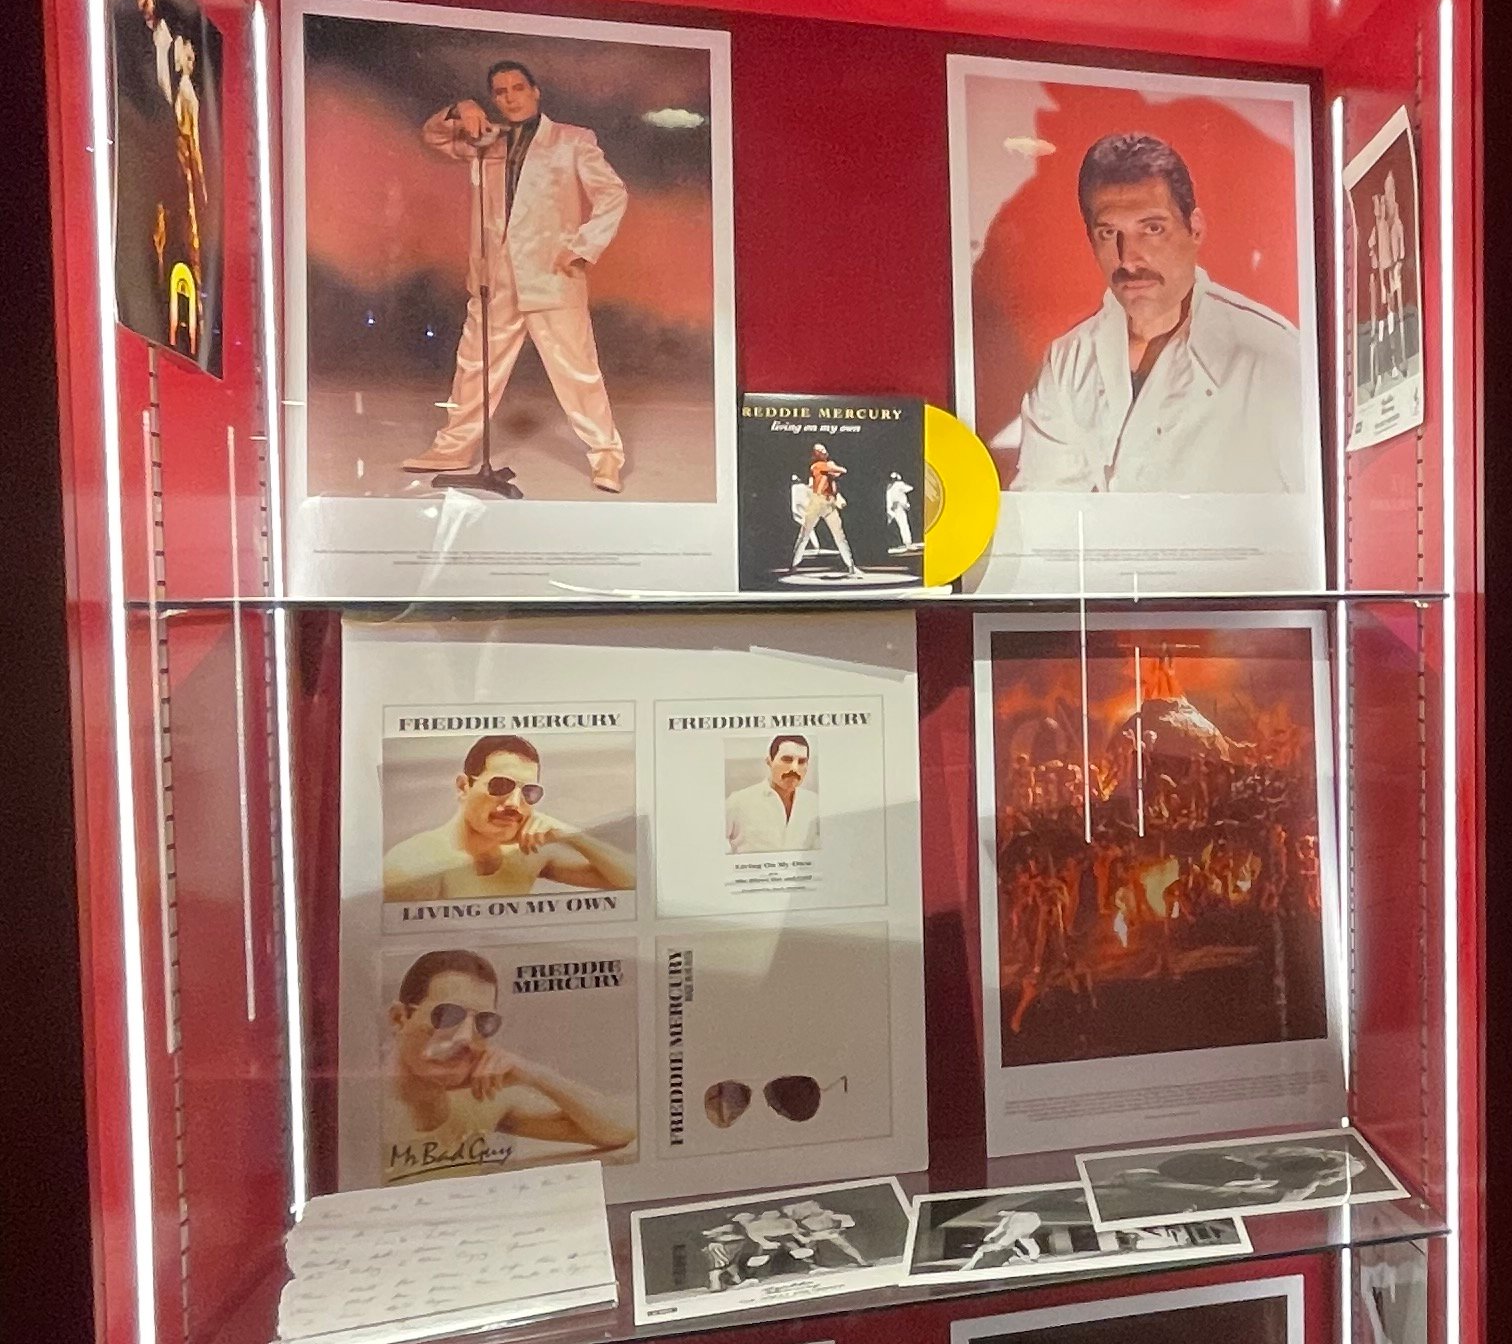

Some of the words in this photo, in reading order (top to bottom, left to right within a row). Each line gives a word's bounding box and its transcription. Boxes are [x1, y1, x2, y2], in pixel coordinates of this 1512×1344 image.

[741, 406, 811, 419] REDDIE
[818, 408, 903, 421] MERCURY
[399, 715, 506, 732] FREDDIE
[511, 713, 621, 730] MERCURY
[668, 715, 766, 731] FREDDIE
[771, 712, 871, 728] MERCURY
[402, 905, 481, 922] LIVING
[488, 902, 521, 917] ON
[525, 898, 561, 915] MY
[565, 895, 618, 913] OWN
[515, 959, 622, 979] FREDDIE
[512, 972, 624, 995] MERCURY
[668, 948, 684, 1048] MERCURY
[669, 1052, 684, 1146] FREDDIE
[421, 1141, 465, 1166] Bad
